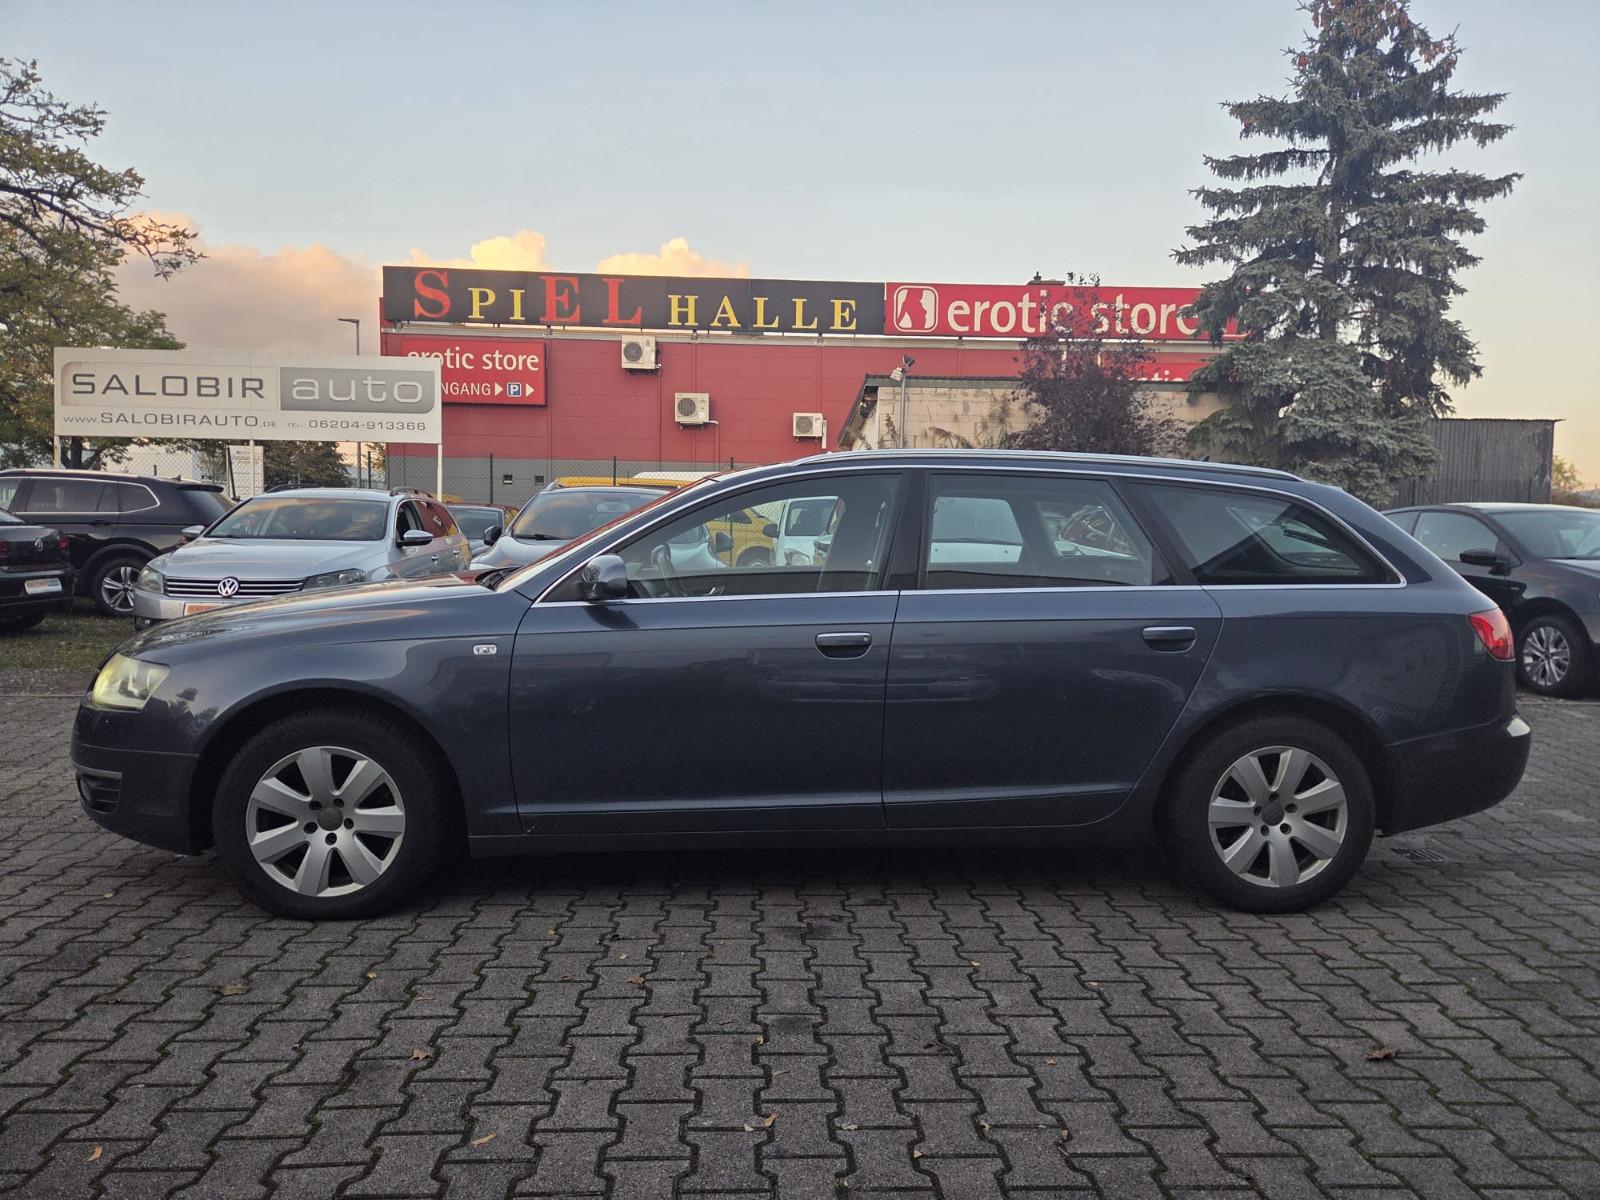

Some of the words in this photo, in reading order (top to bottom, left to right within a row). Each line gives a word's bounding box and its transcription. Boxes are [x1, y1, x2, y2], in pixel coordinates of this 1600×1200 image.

[413, 269, 642, 326] SPIEL
[667, 294, 857, 331] HALLE
[947, 289, 1074, 334] erotic
[1090, 294, 1200, 336] store
[482, 350, 540, 371] store
[72, 373, 266, 399] SALOBIR
[291, 375, 424, 404] auto
[308, 419, 427, 431] 06204-913366
